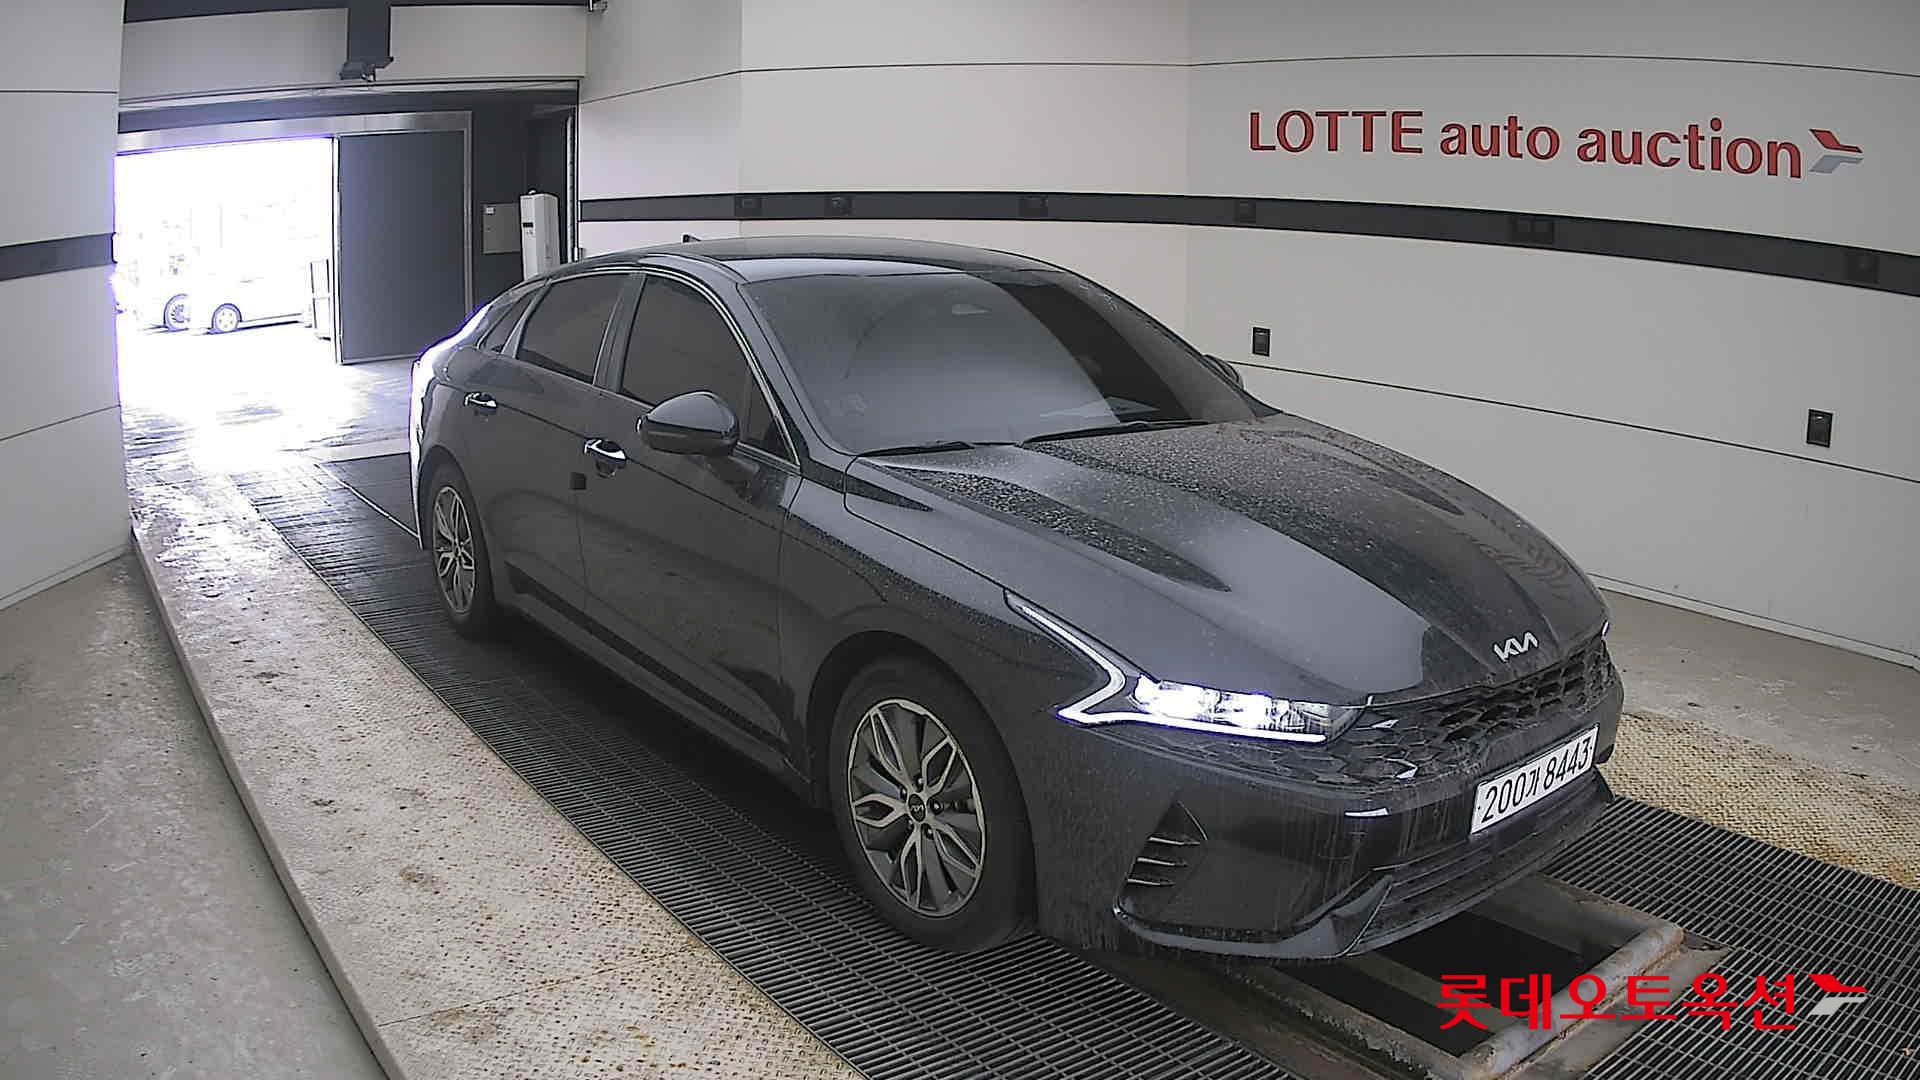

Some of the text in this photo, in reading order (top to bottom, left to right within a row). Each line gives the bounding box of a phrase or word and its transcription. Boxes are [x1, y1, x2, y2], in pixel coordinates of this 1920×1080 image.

[1249, 111, 1802, 179] LOTTE auto auction
[1543, 736, 1591, 790] 8443
